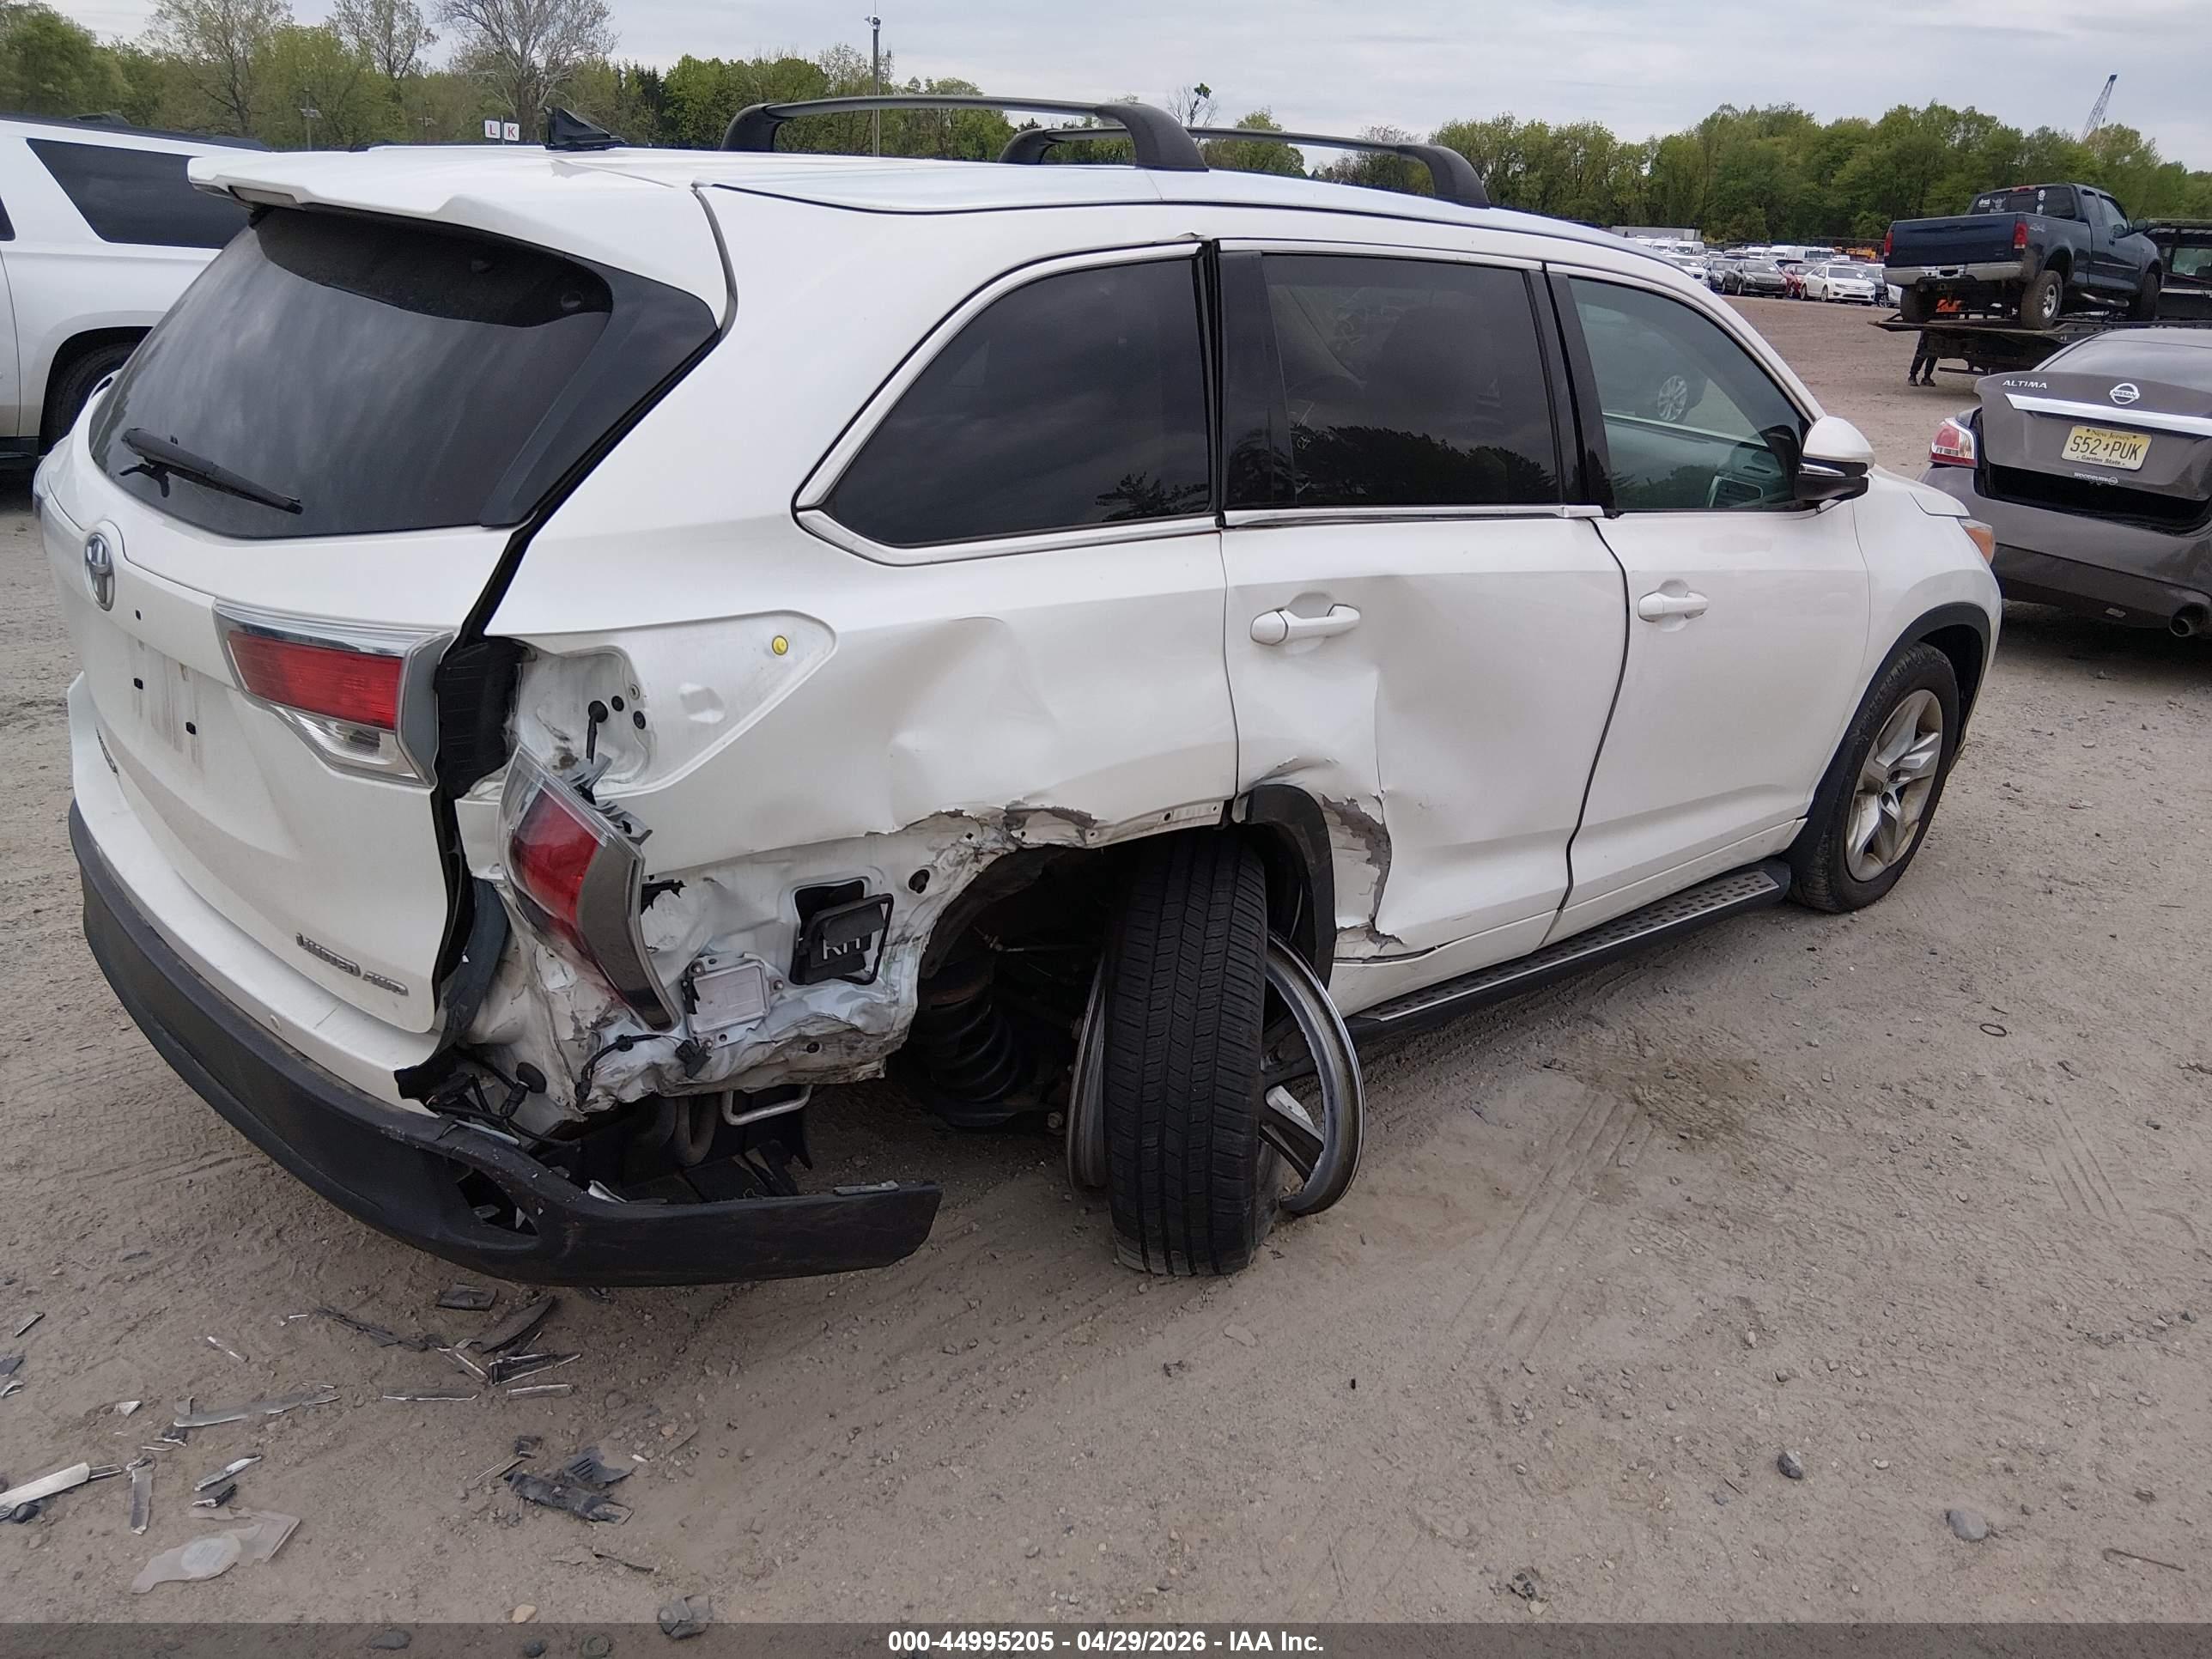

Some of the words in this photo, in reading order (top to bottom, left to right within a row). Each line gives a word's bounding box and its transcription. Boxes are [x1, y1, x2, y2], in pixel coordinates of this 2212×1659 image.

[489, 124, 496, 136] L
[507, 126, 515, 138] K
[2002, 380, 2048, 390] ALTIMA
[2112, 390, 2136, 398] NISSAN
[2108, 432, 2131, 441] Jersey
[2069, 435, 2102, 456] S52
[2109, 441, 2142, 461] PUK
[2081, 454, 2103, 463] Garden
